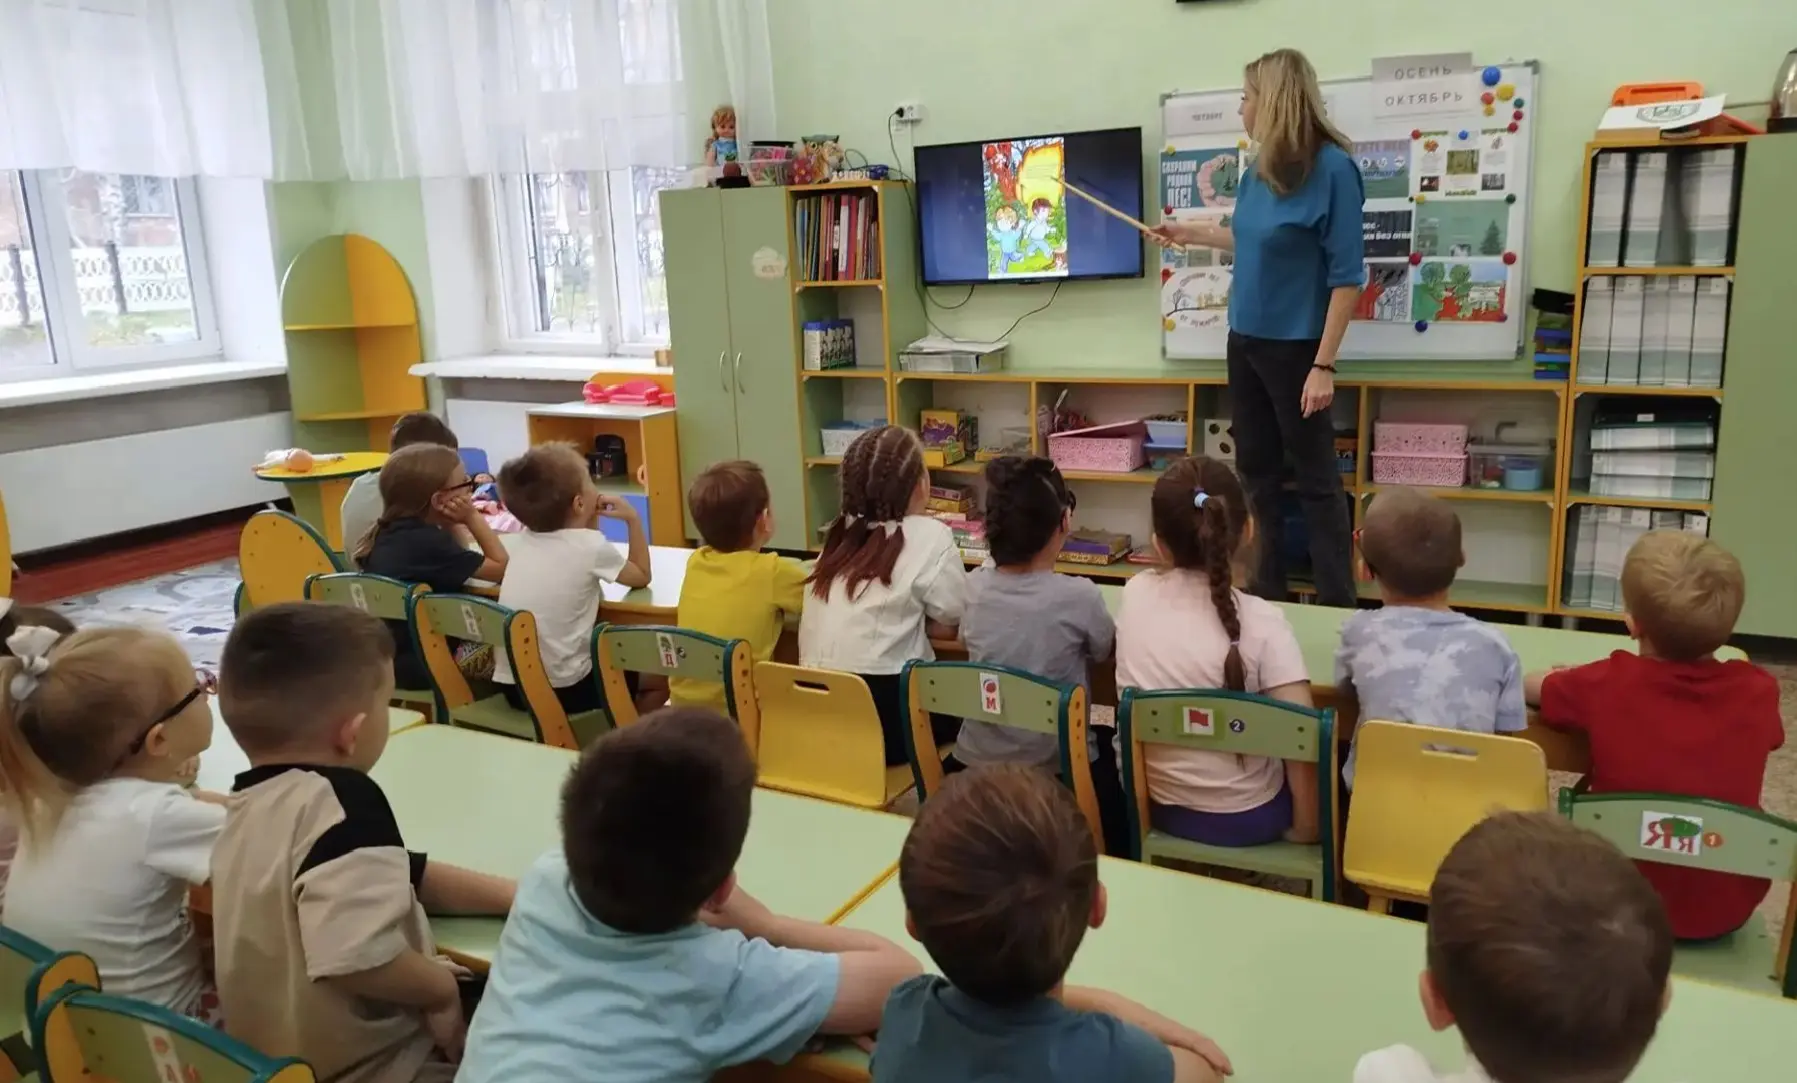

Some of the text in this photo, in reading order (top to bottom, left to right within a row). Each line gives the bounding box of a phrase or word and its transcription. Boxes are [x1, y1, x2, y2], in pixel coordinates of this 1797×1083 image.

[1394, 65, 1452, 80] ОСЕНЬ
[1384, 91, 1463, 107] ОКТЯБРЬ
[1167, 188, 1191, 208] ЛЕС!
